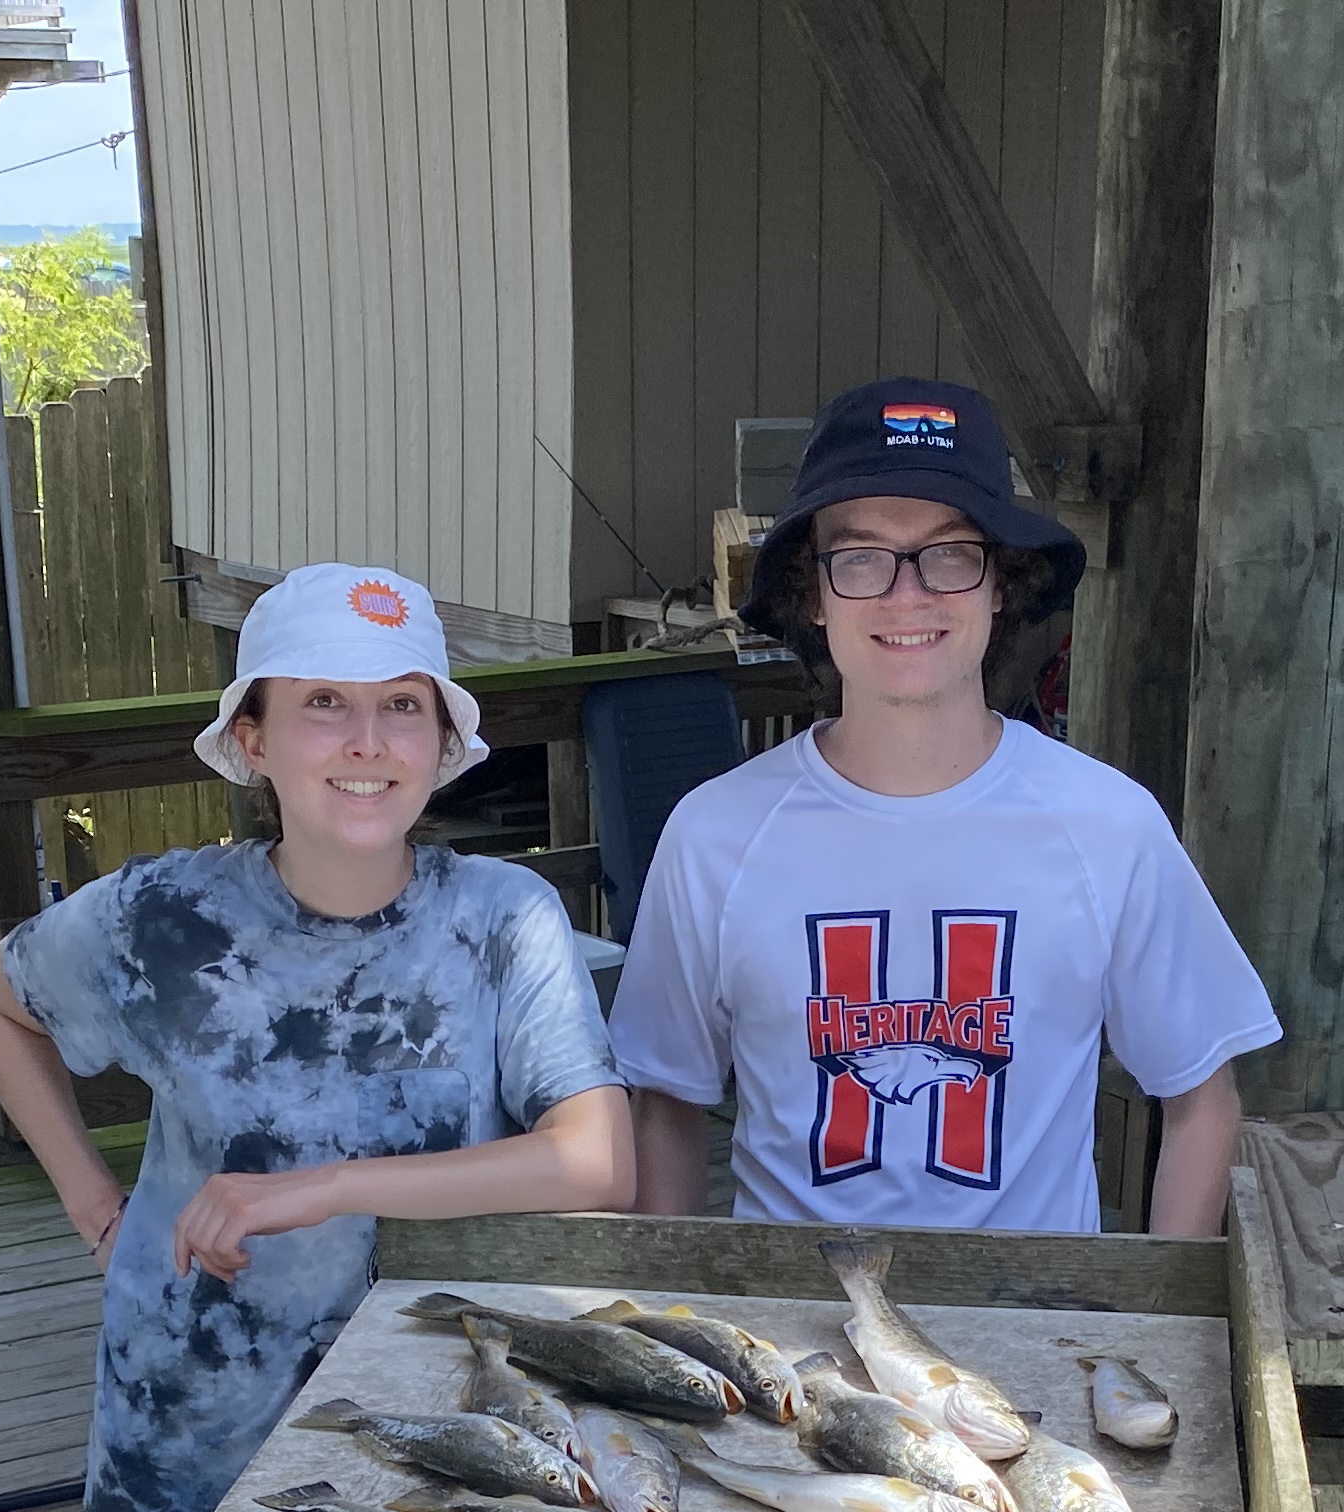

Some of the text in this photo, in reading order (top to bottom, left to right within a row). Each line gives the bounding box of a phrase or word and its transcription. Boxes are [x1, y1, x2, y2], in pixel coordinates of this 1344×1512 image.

[886, 434, 954, 450] MOAB UTAH
[359, 592, 400, 618] SUNS
[807, 997, 1013, 1059] HERITAGE
